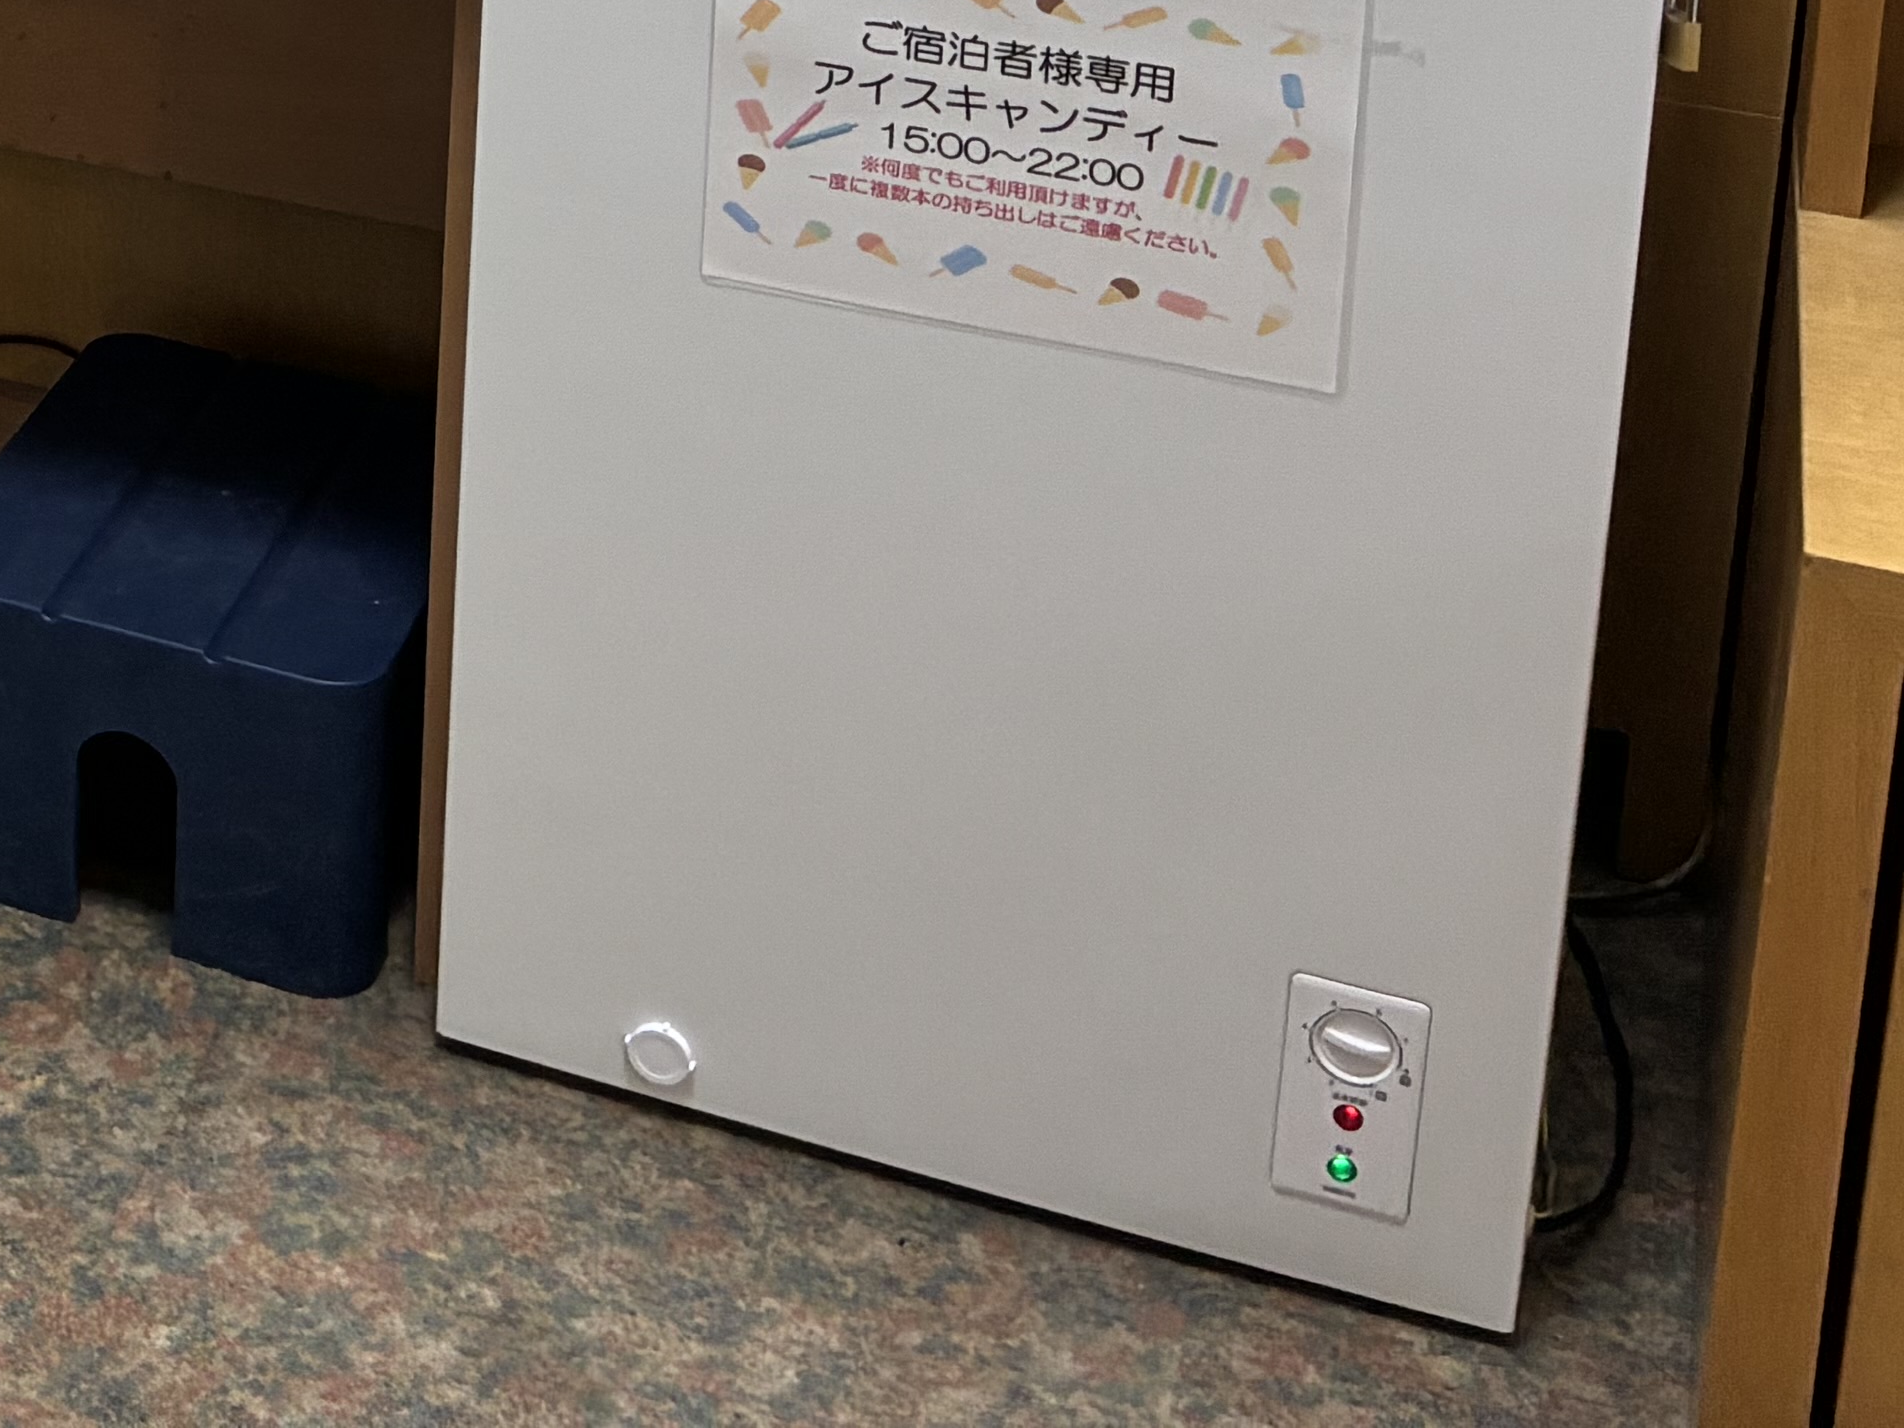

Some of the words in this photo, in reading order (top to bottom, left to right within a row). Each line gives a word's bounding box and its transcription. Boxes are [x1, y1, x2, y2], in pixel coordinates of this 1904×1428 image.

[860, 18, 1176, 104] ご宿泊者様専用
[813, 59, 1220, 153] アイスキャンディー
[809, 173, 1219, 259] 一度に複数本の持ち出しはご遠慮ください。
[861, 155, 1143, 221] ※何度でもご利用頂けますが、
